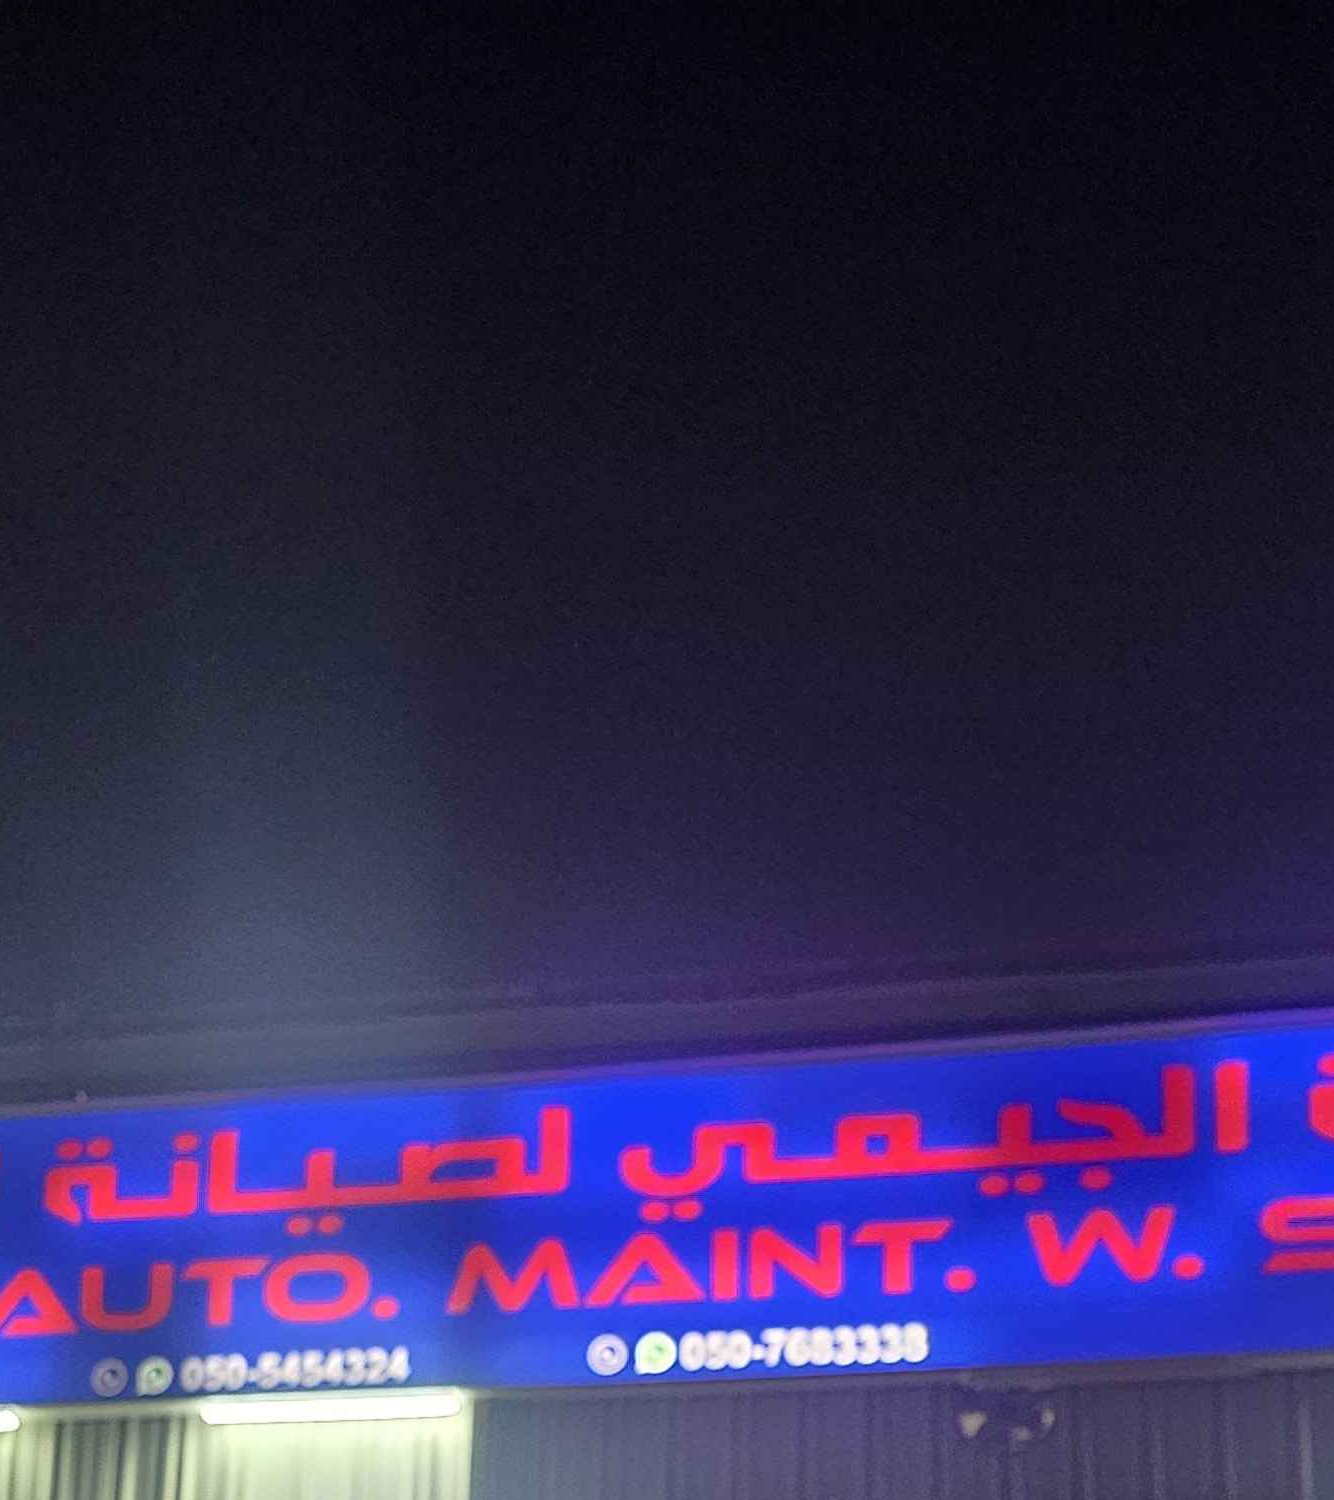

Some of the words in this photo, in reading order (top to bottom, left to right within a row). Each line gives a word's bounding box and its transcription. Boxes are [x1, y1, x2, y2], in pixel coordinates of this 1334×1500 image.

[42, 1104, 573, 1238] لصيانة
[618, 1060, 1250, 1223] الجيمي
[446, 1217, 977, 1314] MAINT.
[1026, 1204, 1205, 1288] W.
